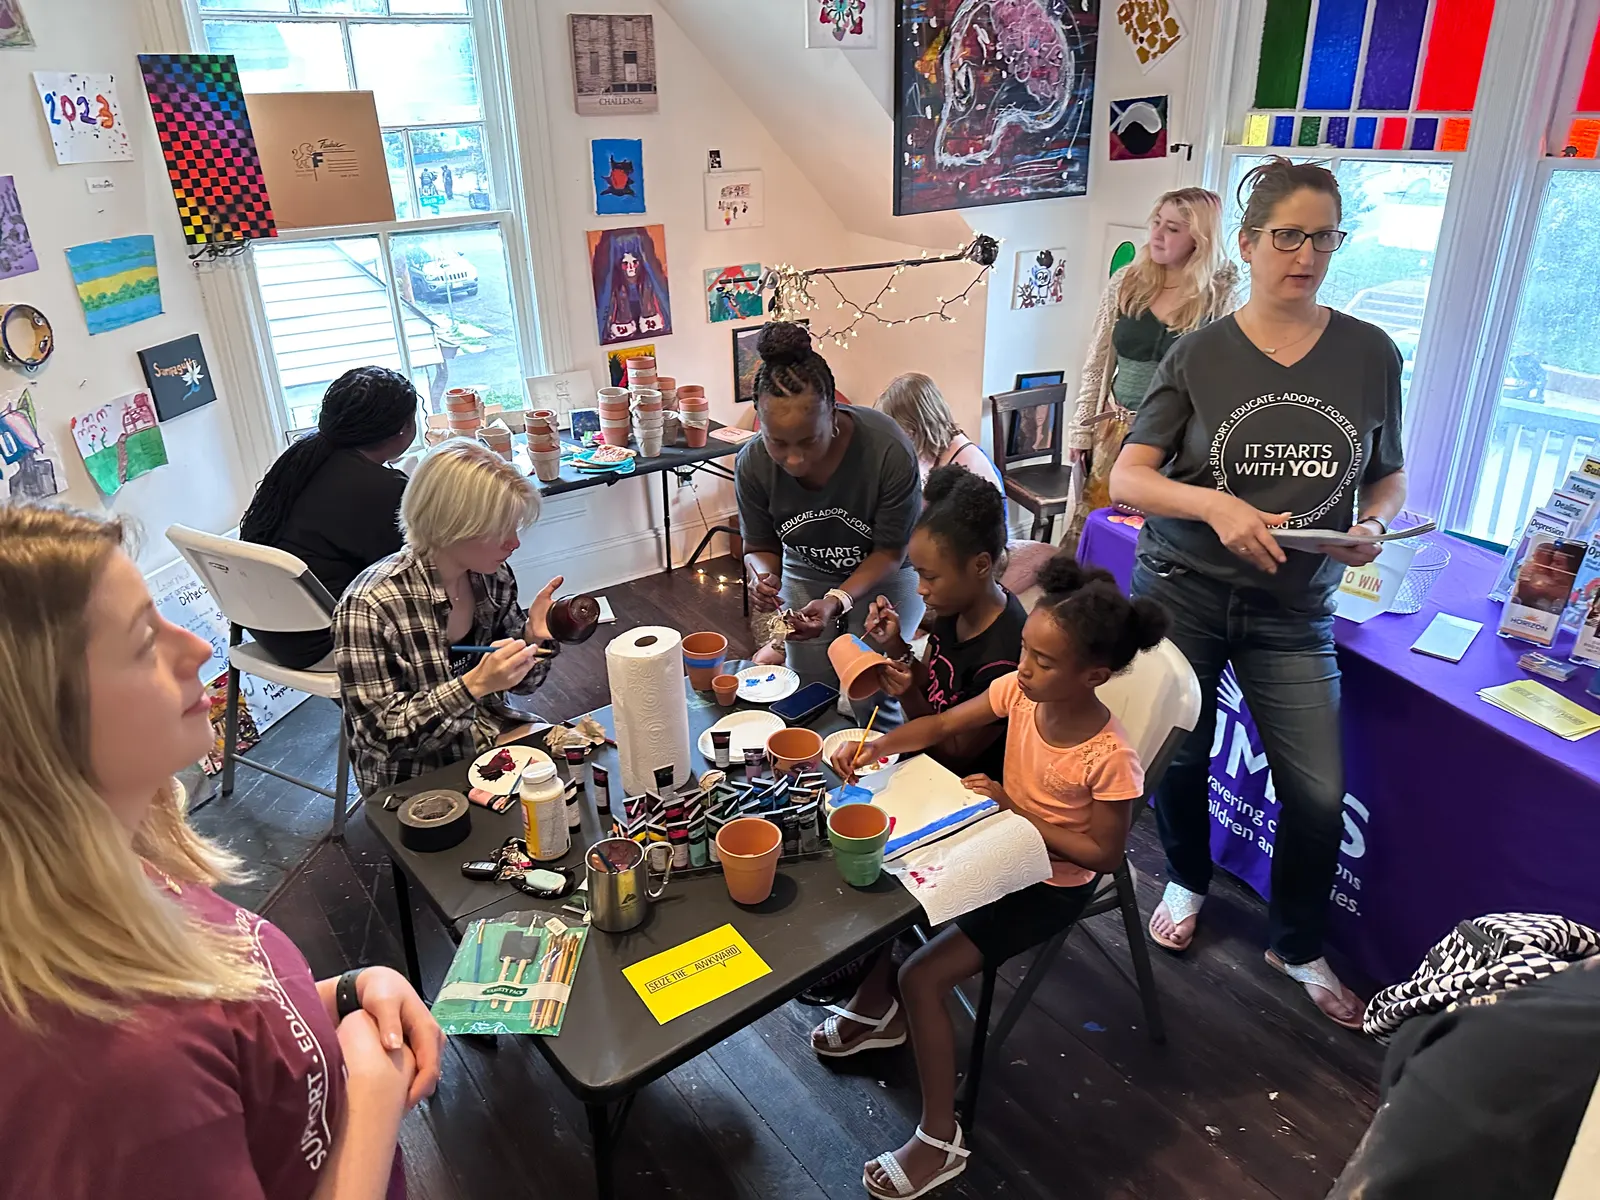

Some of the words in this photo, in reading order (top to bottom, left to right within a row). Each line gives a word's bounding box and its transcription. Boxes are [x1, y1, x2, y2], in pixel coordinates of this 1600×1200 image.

[44, 92, 114, 129] 2023
[598, 97, 644, 106] CHALLENGE
[1230, 393, 1276, 420] EDUCATE
[1282, 392, 1322, 408] ADOPT
[1324, 404, 1358, 440] FOSTER
[1210, 420, 1231, 467] SUPPORT
[1244, 443, 1262, 459] IT
[1264, 443, 1333, 459] STARTS
[1234, 462, 1285, 477] WITH
[1288, 460, 1339, 479] YOU
[1344, 442, 1363, 487] MENTOR
[1570, 483, 1597, 500] Moving
[1295, 490, 1344, 529] ADVOCATE
[1553, 499, 1582, 517] Dealing
[781, 510, 814, 532] EDUCATE
[818, 507, 848, 519] ADOPT
[849, 517, 872, 537] FOST
[1530, 518, 1565, 537] Depression
[795, 545, 809, 555] IT
[809, 545, 861, 559] STARTS
[1588, 546, 1600, 559] Op
[1344, 569, 1355, 584] O
[1358, 574, 1384, 593] WIN
[1510, 617, 1548, 632] HORIZON
[1207, 775, 1265, 827] avering
[1257, 835, 1274, 858] an
[1328, 884, 1362, 917] ies.
[648, 975, 673, 992] SEIZE
[671, 968, 688, 981] THE
[694, 946, 739, 972] AWKWARD
[301, 1072, 327, 1171] SUPPORT
